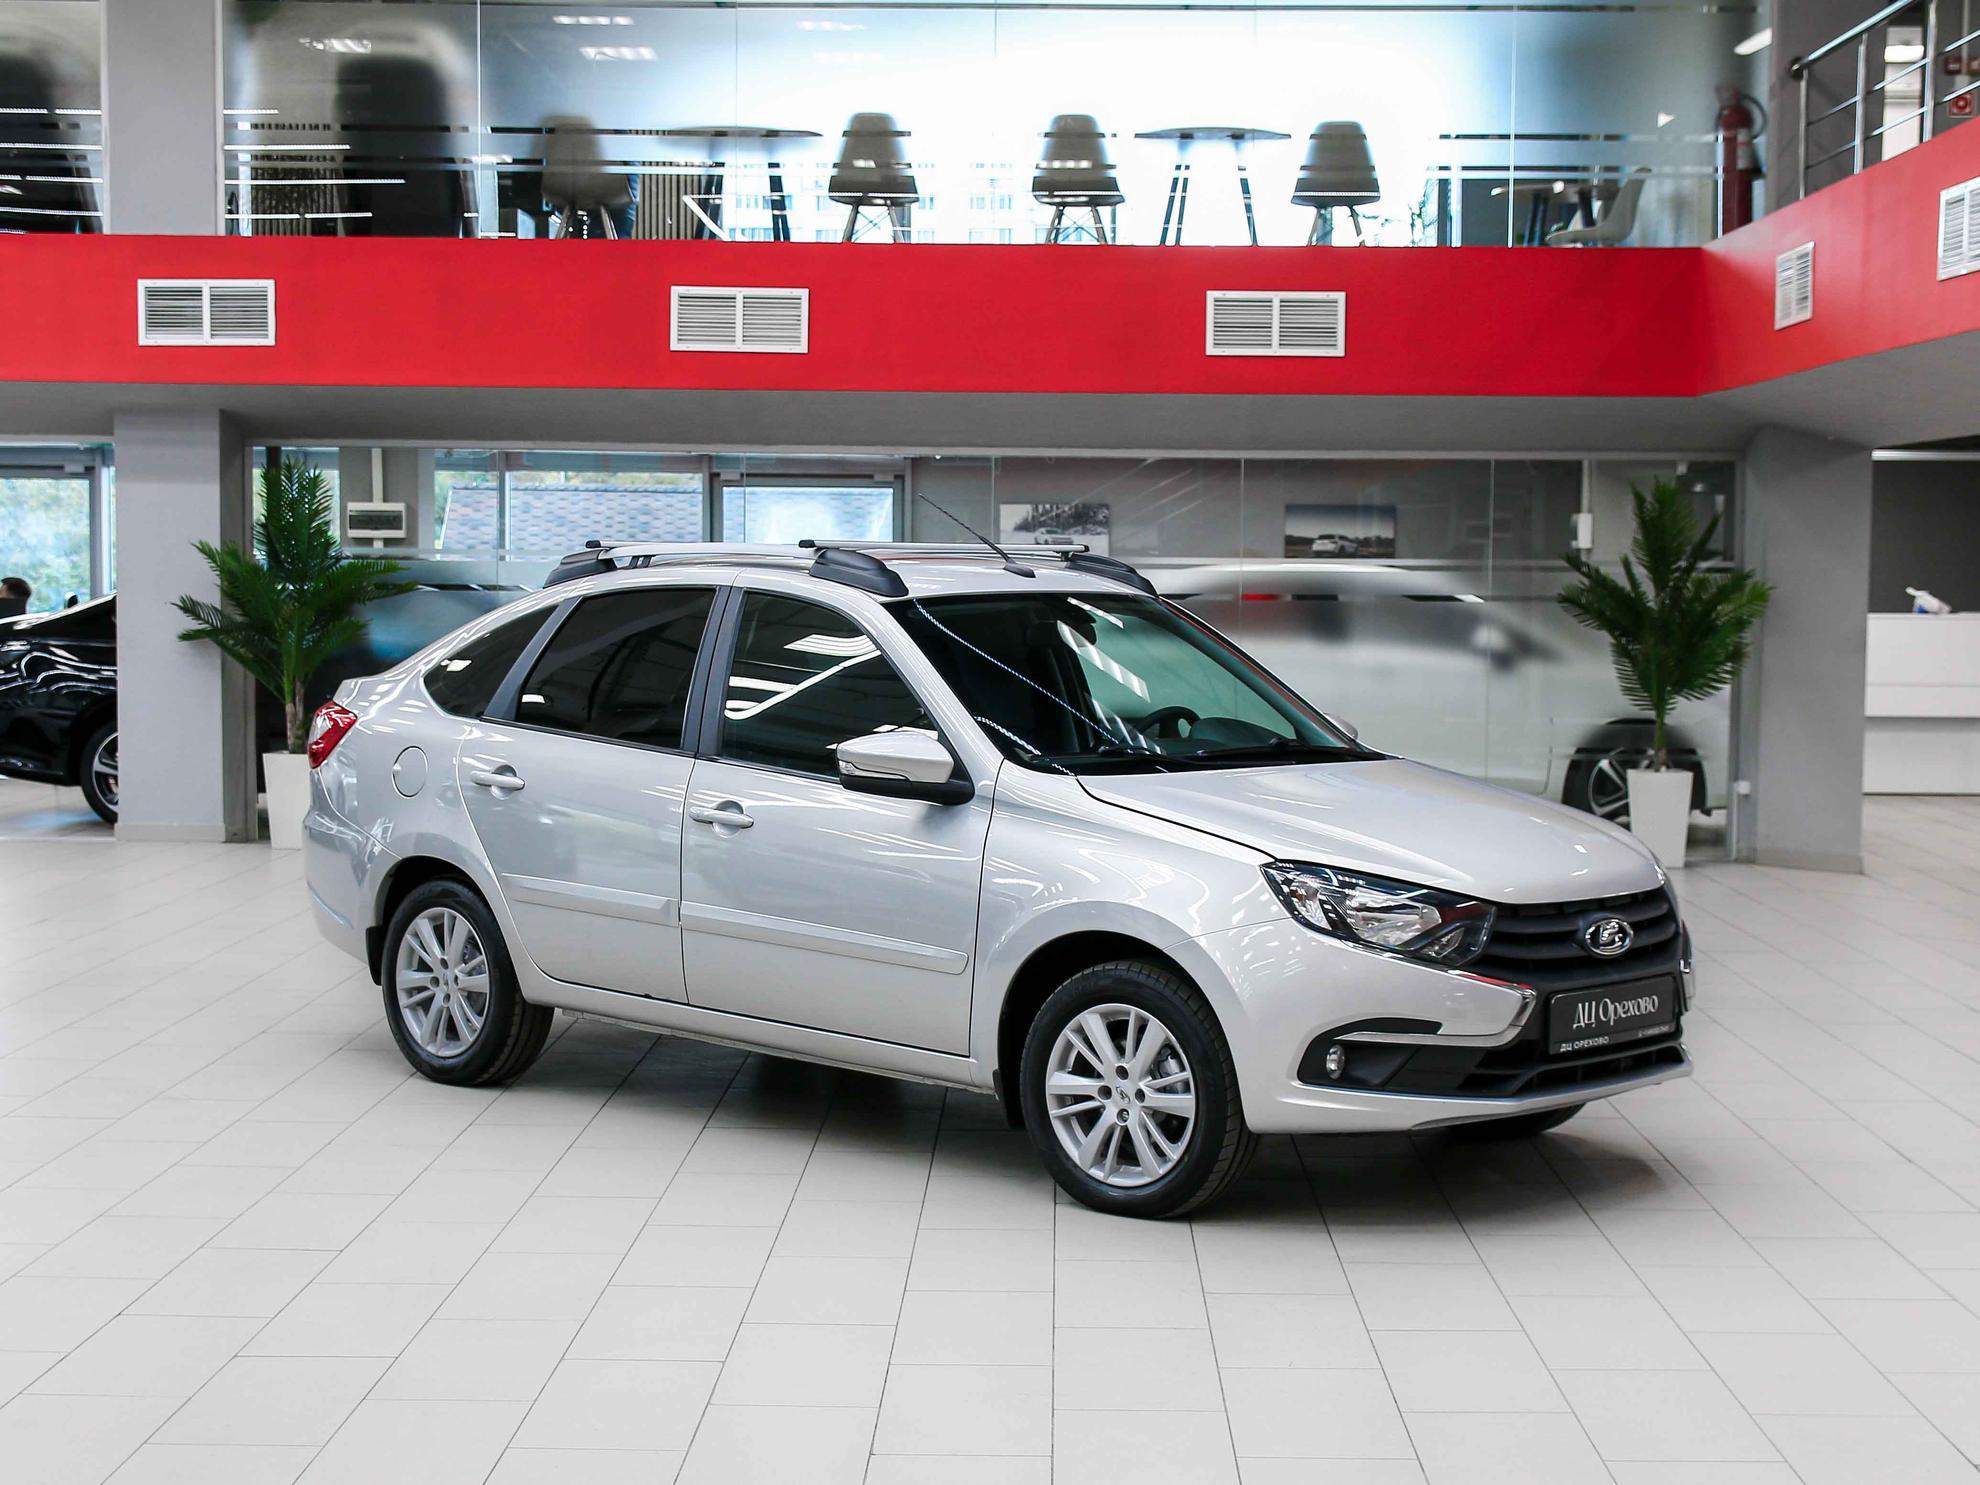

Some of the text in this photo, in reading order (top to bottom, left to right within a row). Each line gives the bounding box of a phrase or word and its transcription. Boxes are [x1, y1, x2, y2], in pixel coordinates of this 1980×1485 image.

[1572, 995, 1659, 1030] ДЦ Орехово
[1560, 1036, 1610, 1052] ДЦ ОРЕХОВО
